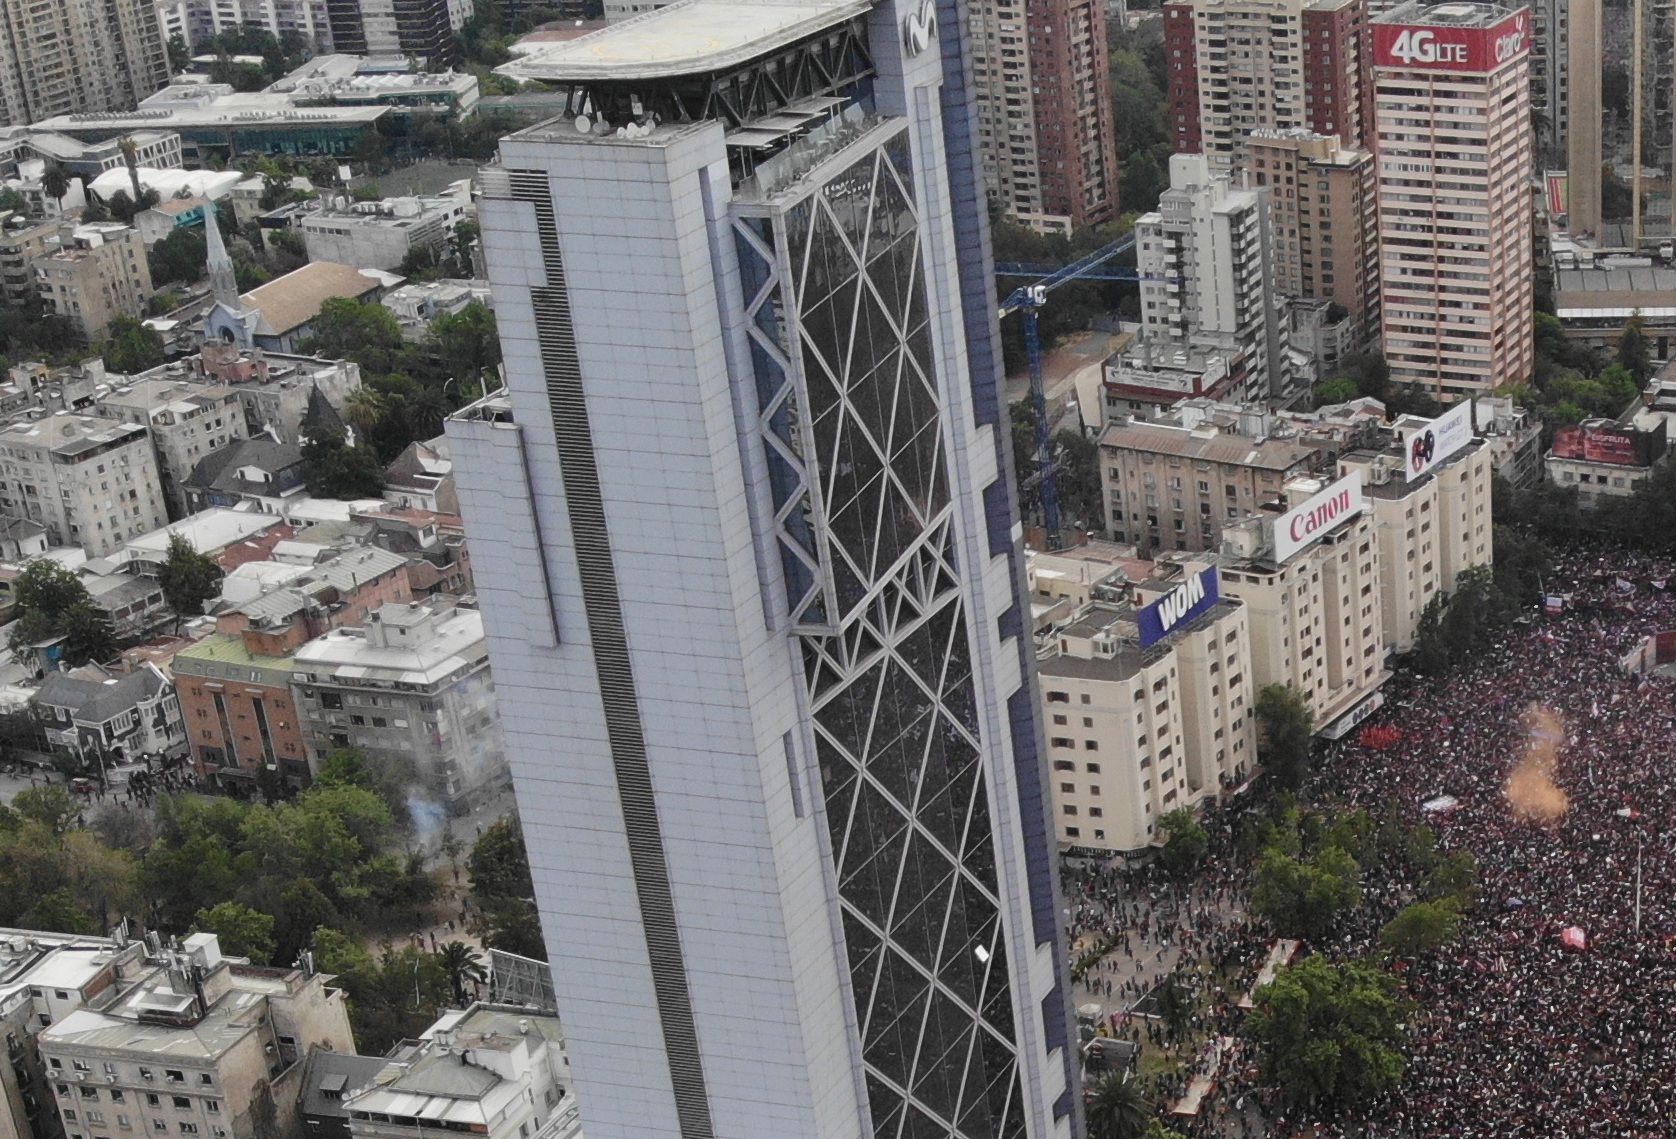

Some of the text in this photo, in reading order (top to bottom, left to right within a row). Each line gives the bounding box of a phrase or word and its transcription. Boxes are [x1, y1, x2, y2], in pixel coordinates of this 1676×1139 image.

[1495, 32, 1523, 62] Claro
[1290, 489, 1350, 542] Canon
[1158, 572, 1205, 631] WOM
